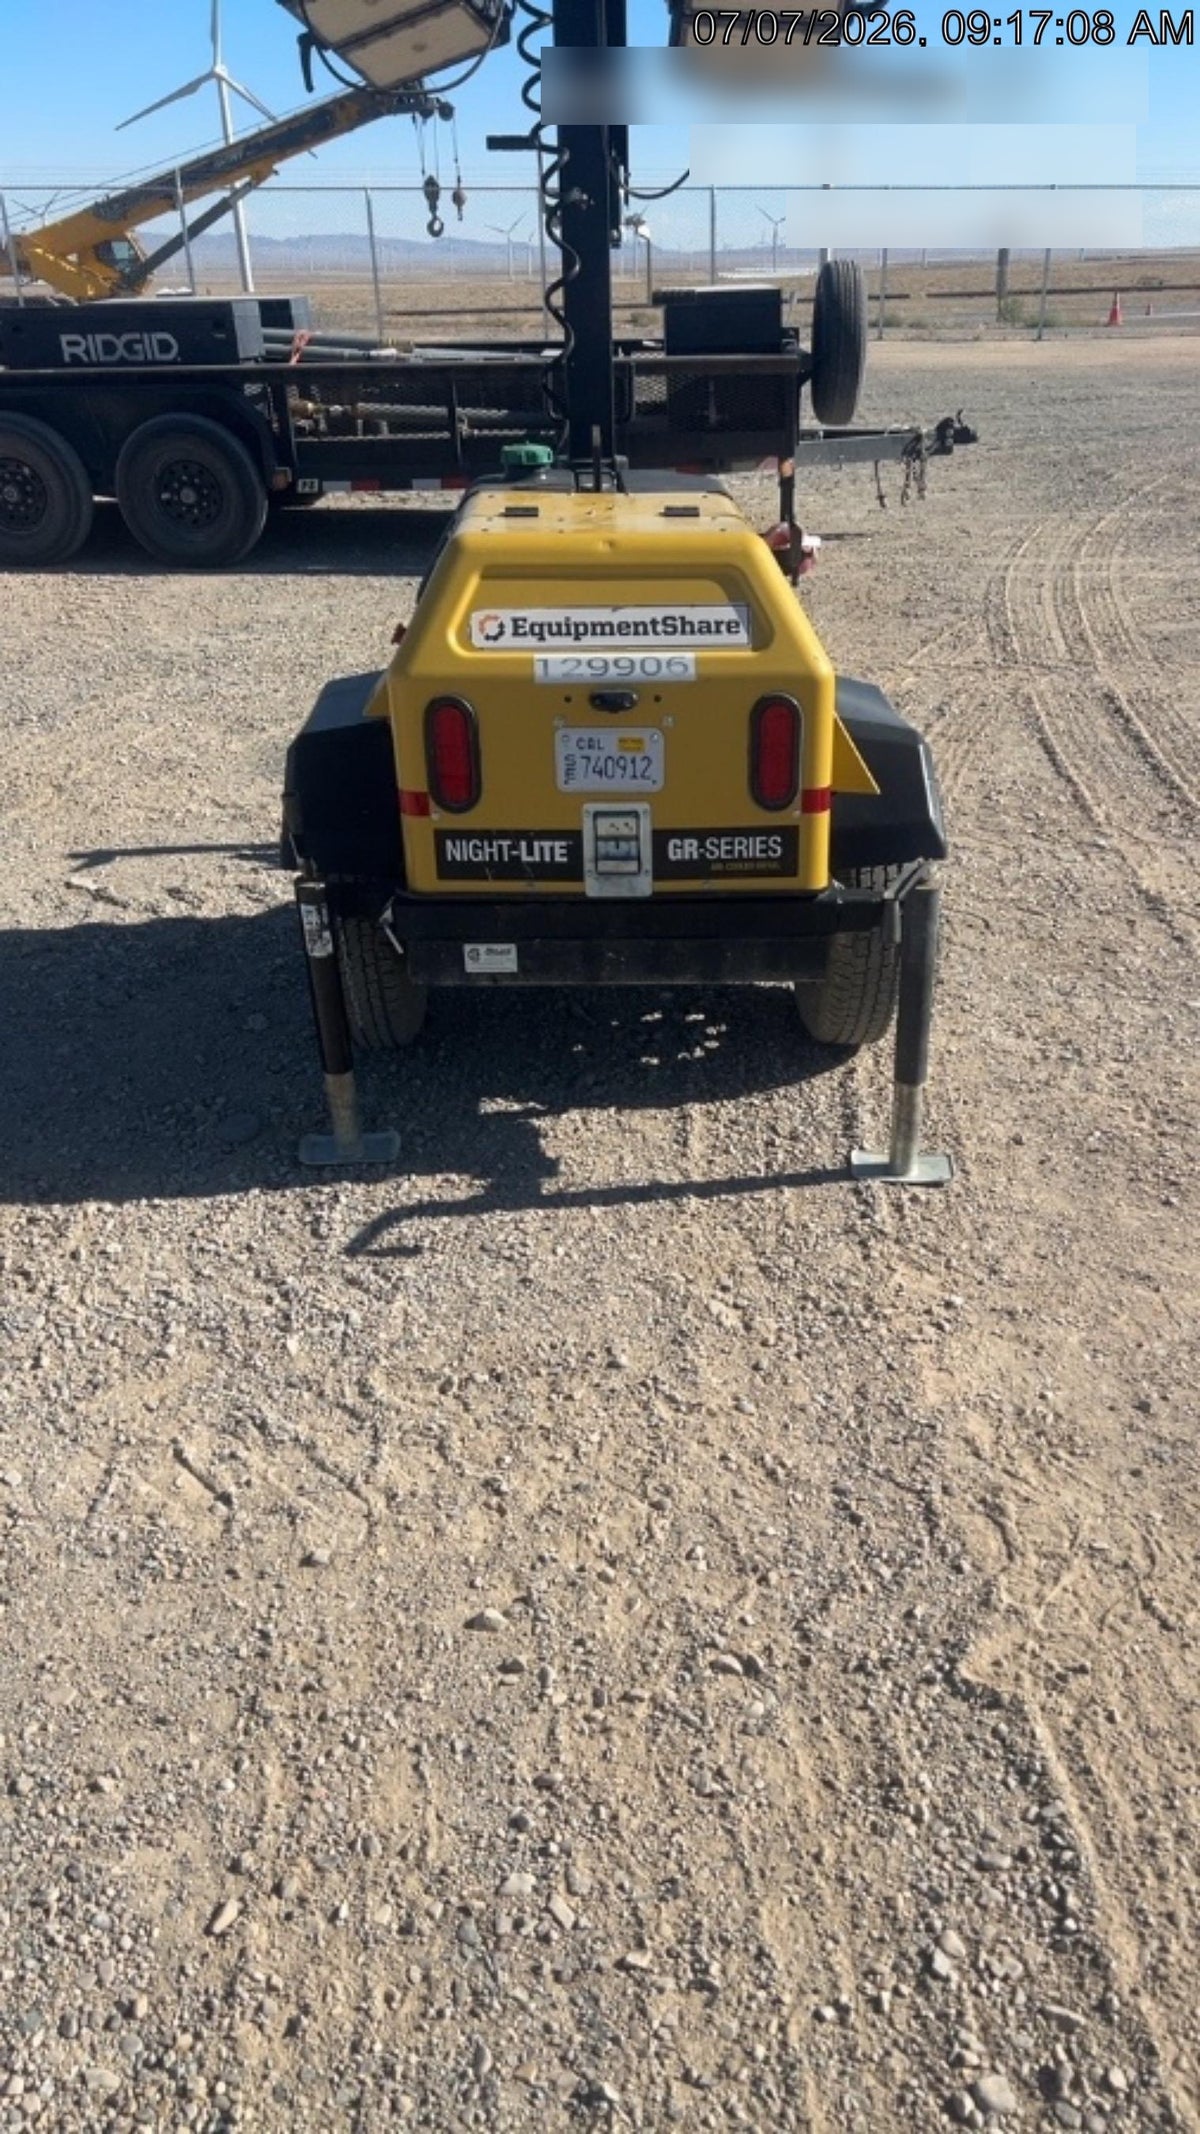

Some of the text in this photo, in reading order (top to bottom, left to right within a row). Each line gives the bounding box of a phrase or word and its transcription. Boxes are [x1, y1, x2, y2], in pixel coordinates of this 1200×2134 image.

[60, 331, 180, 362] RIDGID
[511, 615, 741, 641] EquipmentShare
[536, 655, 690, 679] 129906
[580, 754, 653, 780] 740912
[667, 835, 783, 861] GR-SERIES
